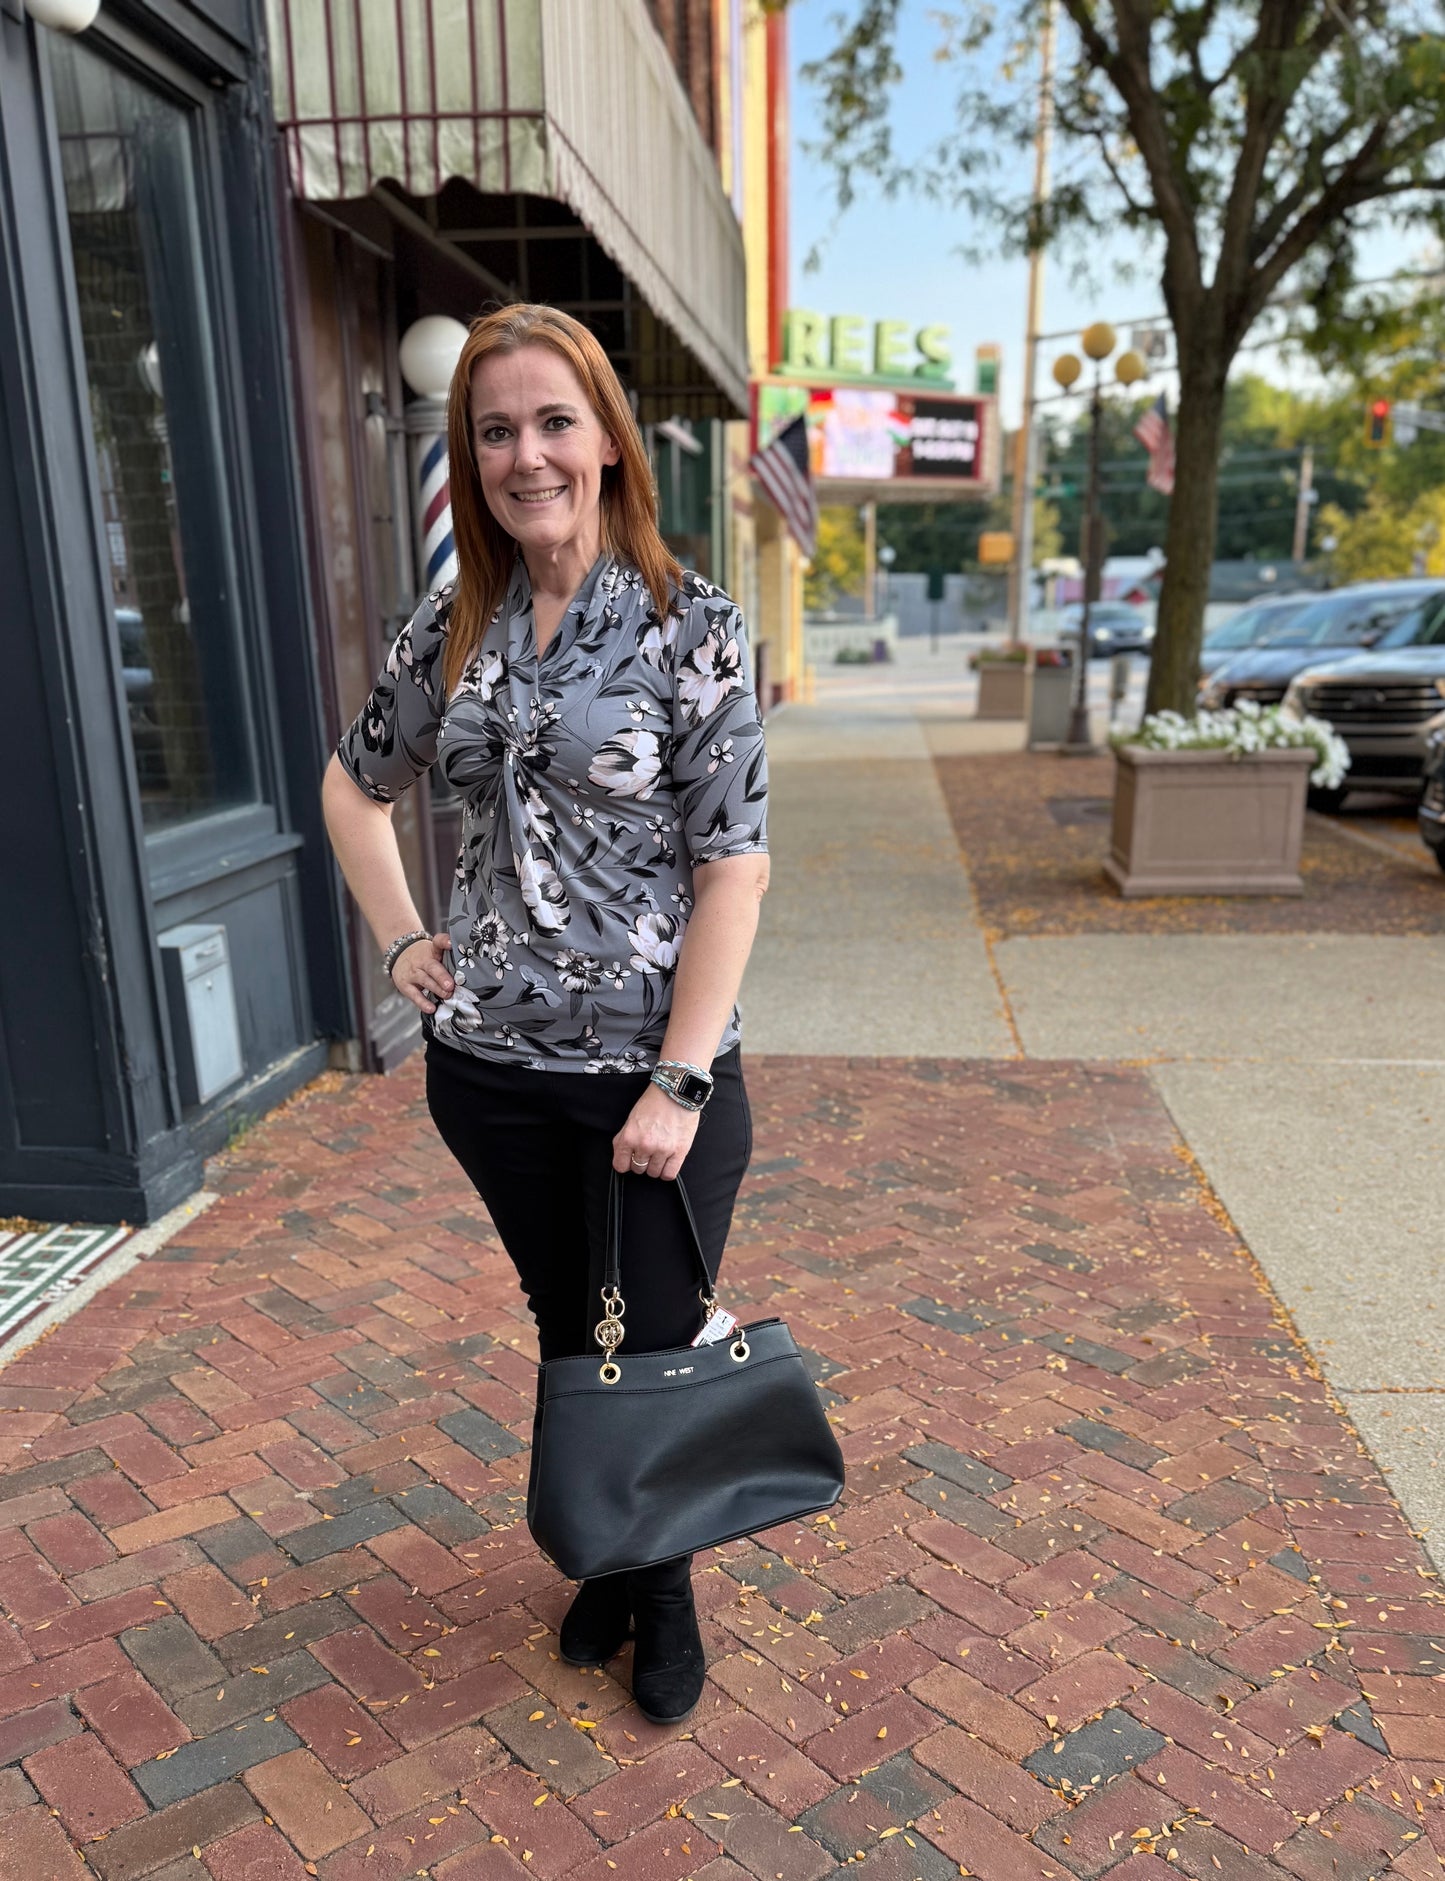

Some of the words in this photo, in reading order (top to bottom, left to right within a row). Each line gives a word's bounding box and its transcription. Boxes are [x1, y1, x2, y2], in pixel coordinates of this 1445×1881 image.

[783, 309, 951, 377] REES
[664, 1369, 677, 1377] NINE
[679, 1366, 694, 1375] WEST
